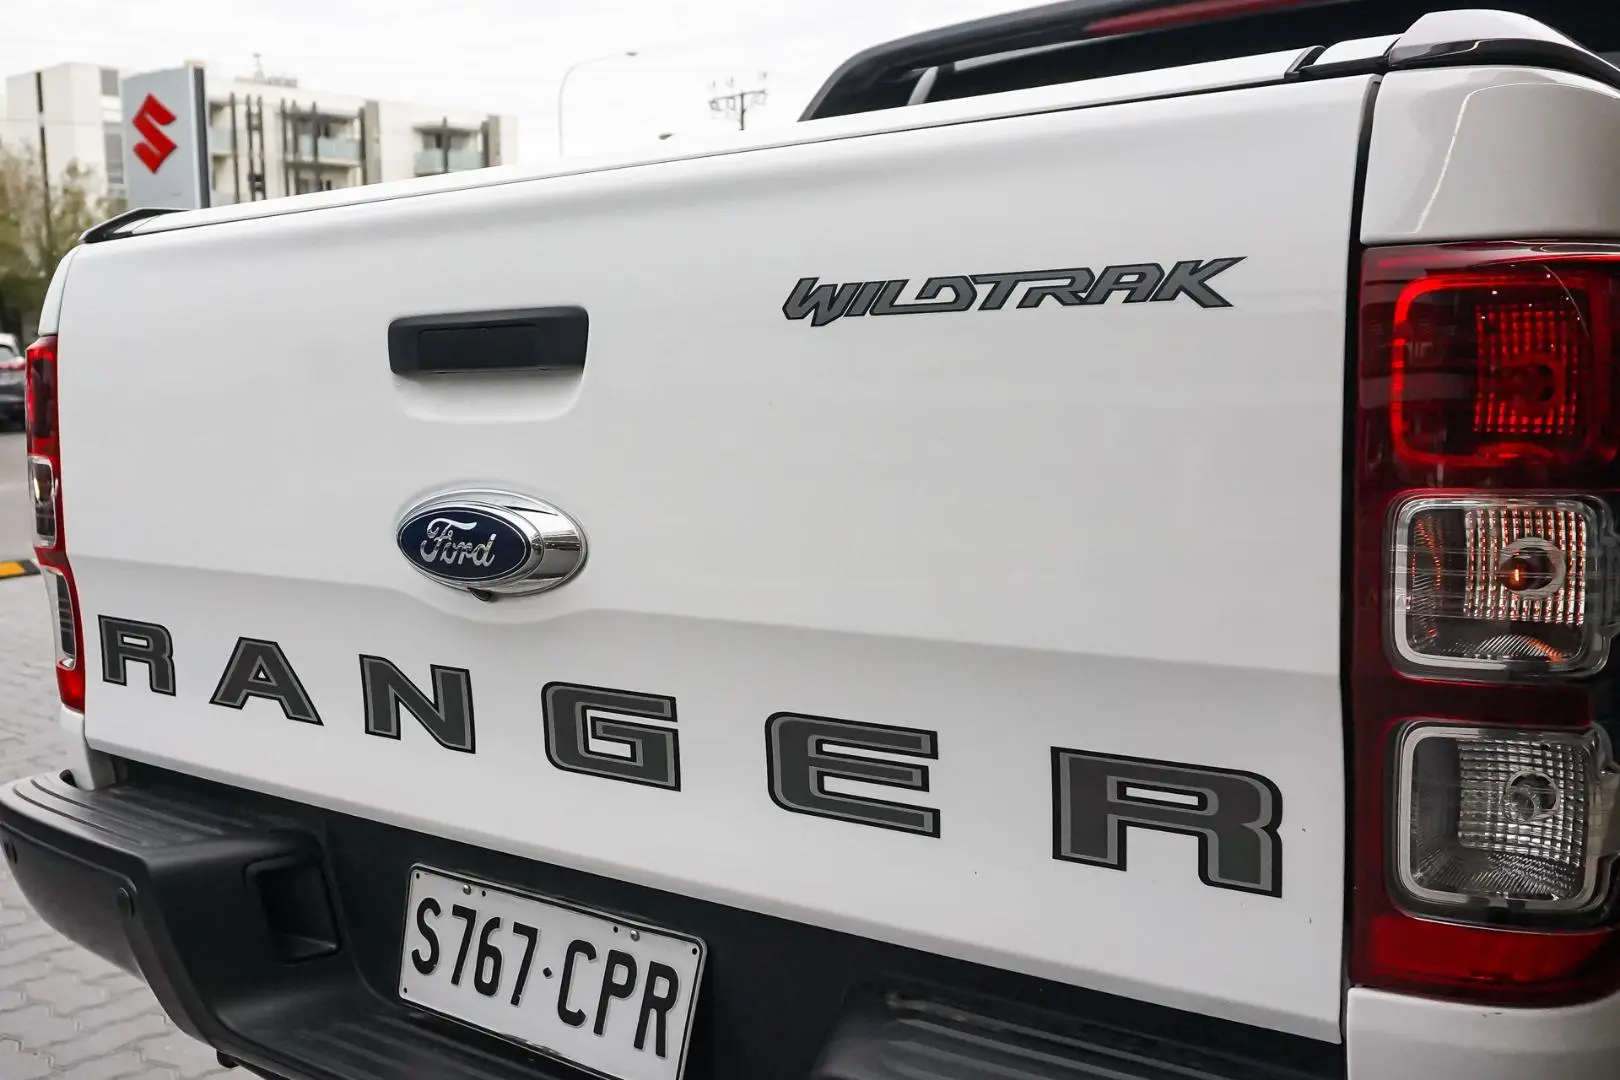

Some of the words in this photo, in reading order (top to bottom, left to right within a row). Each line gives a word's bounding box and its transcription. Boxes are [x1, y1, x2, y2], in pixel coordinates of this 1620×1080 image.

[782, 256, 1248, 327] WILDTRAK
[420, 518, 497, 567] Ford
[98, 614, 1283, 898] RANGER
